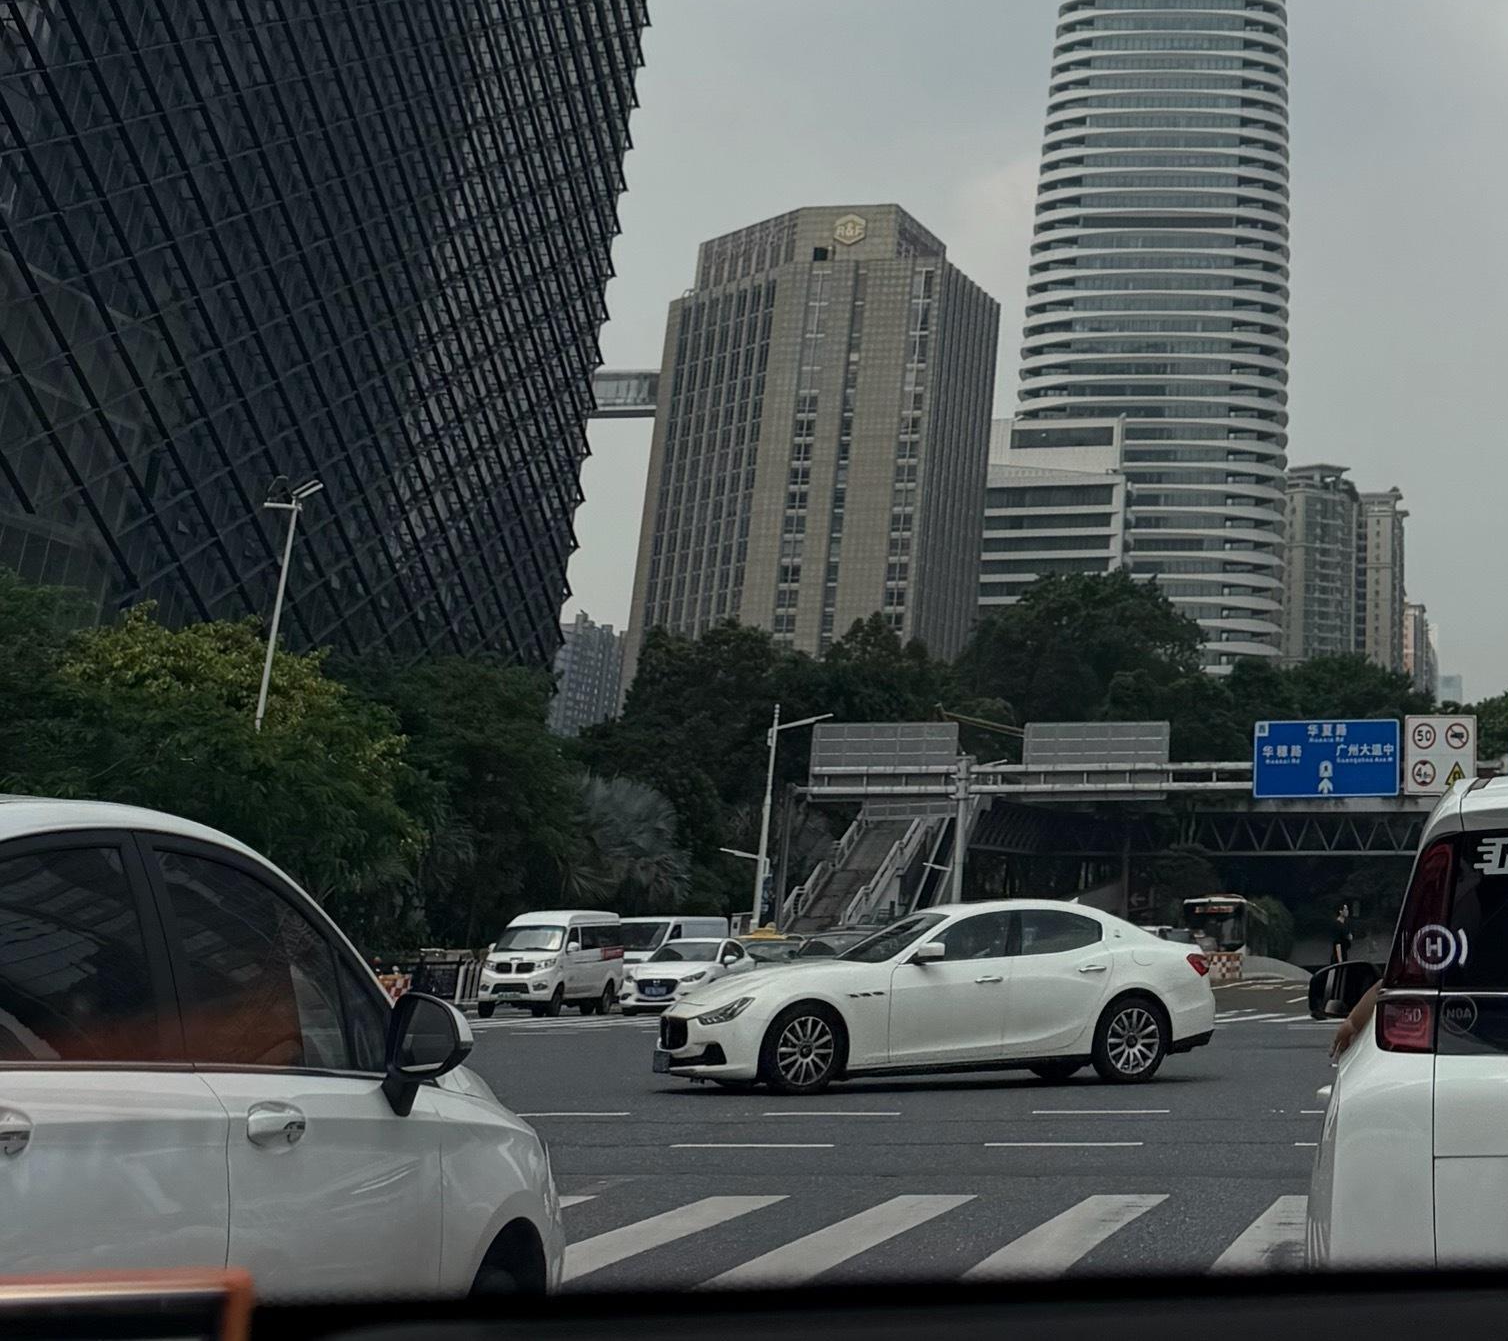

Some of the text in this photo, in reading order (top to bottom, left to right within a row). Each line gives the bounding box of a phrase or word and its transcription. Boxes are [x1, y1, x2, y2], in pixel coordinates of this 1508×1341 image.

[1307, 724, 1347, 737] 华夏路
[1416, 729, 1432, 742] 50
[1336, 744, 1394, 756] 广州大道中
